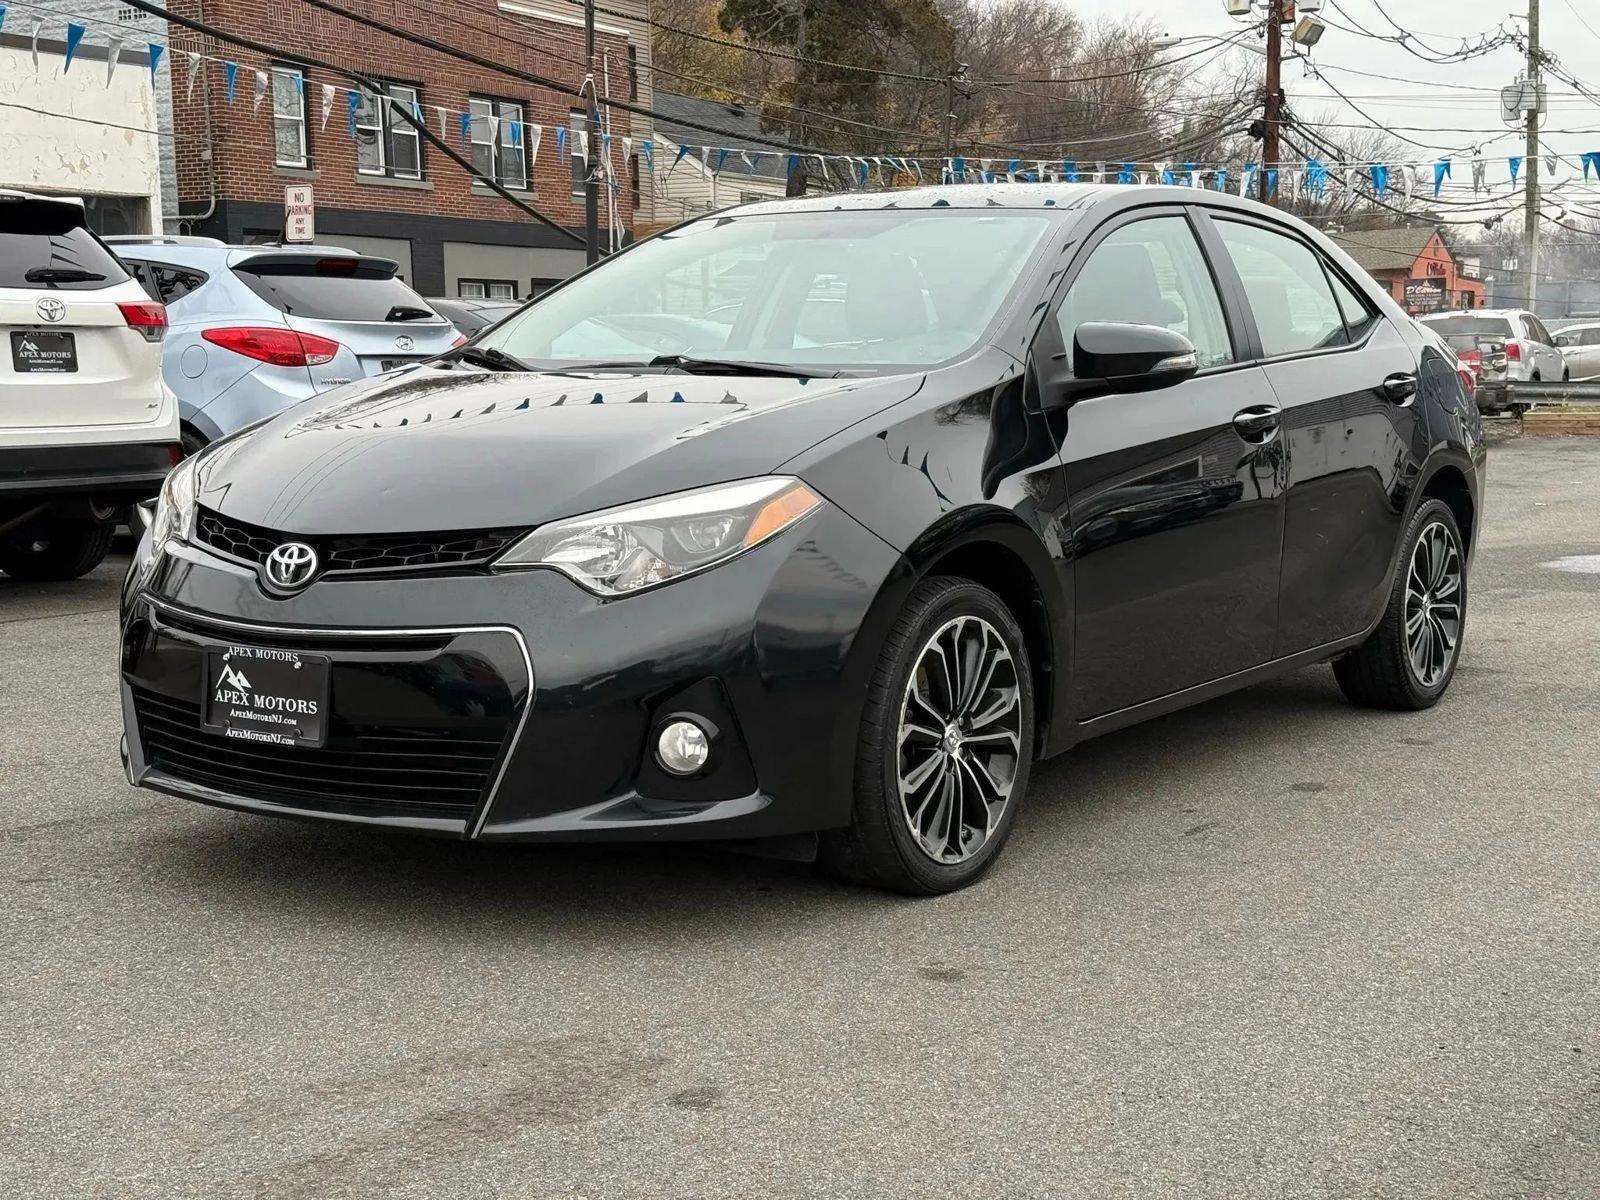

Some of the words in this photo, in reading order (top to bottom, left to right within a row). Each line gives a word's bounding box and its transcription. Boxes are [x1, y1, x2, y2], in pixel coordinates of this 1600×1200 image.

[295, 192, 304, 202] NO
[288, 205, 311, 215] PARKING
[40, 351, 71, 359] MOTORS
[228, 646, 253, 657] APEX
[255, 649, 299, 662] MOTORS
[215, 689, 249, 706] APEX
[254, 695, 317, 714] MOTORS
